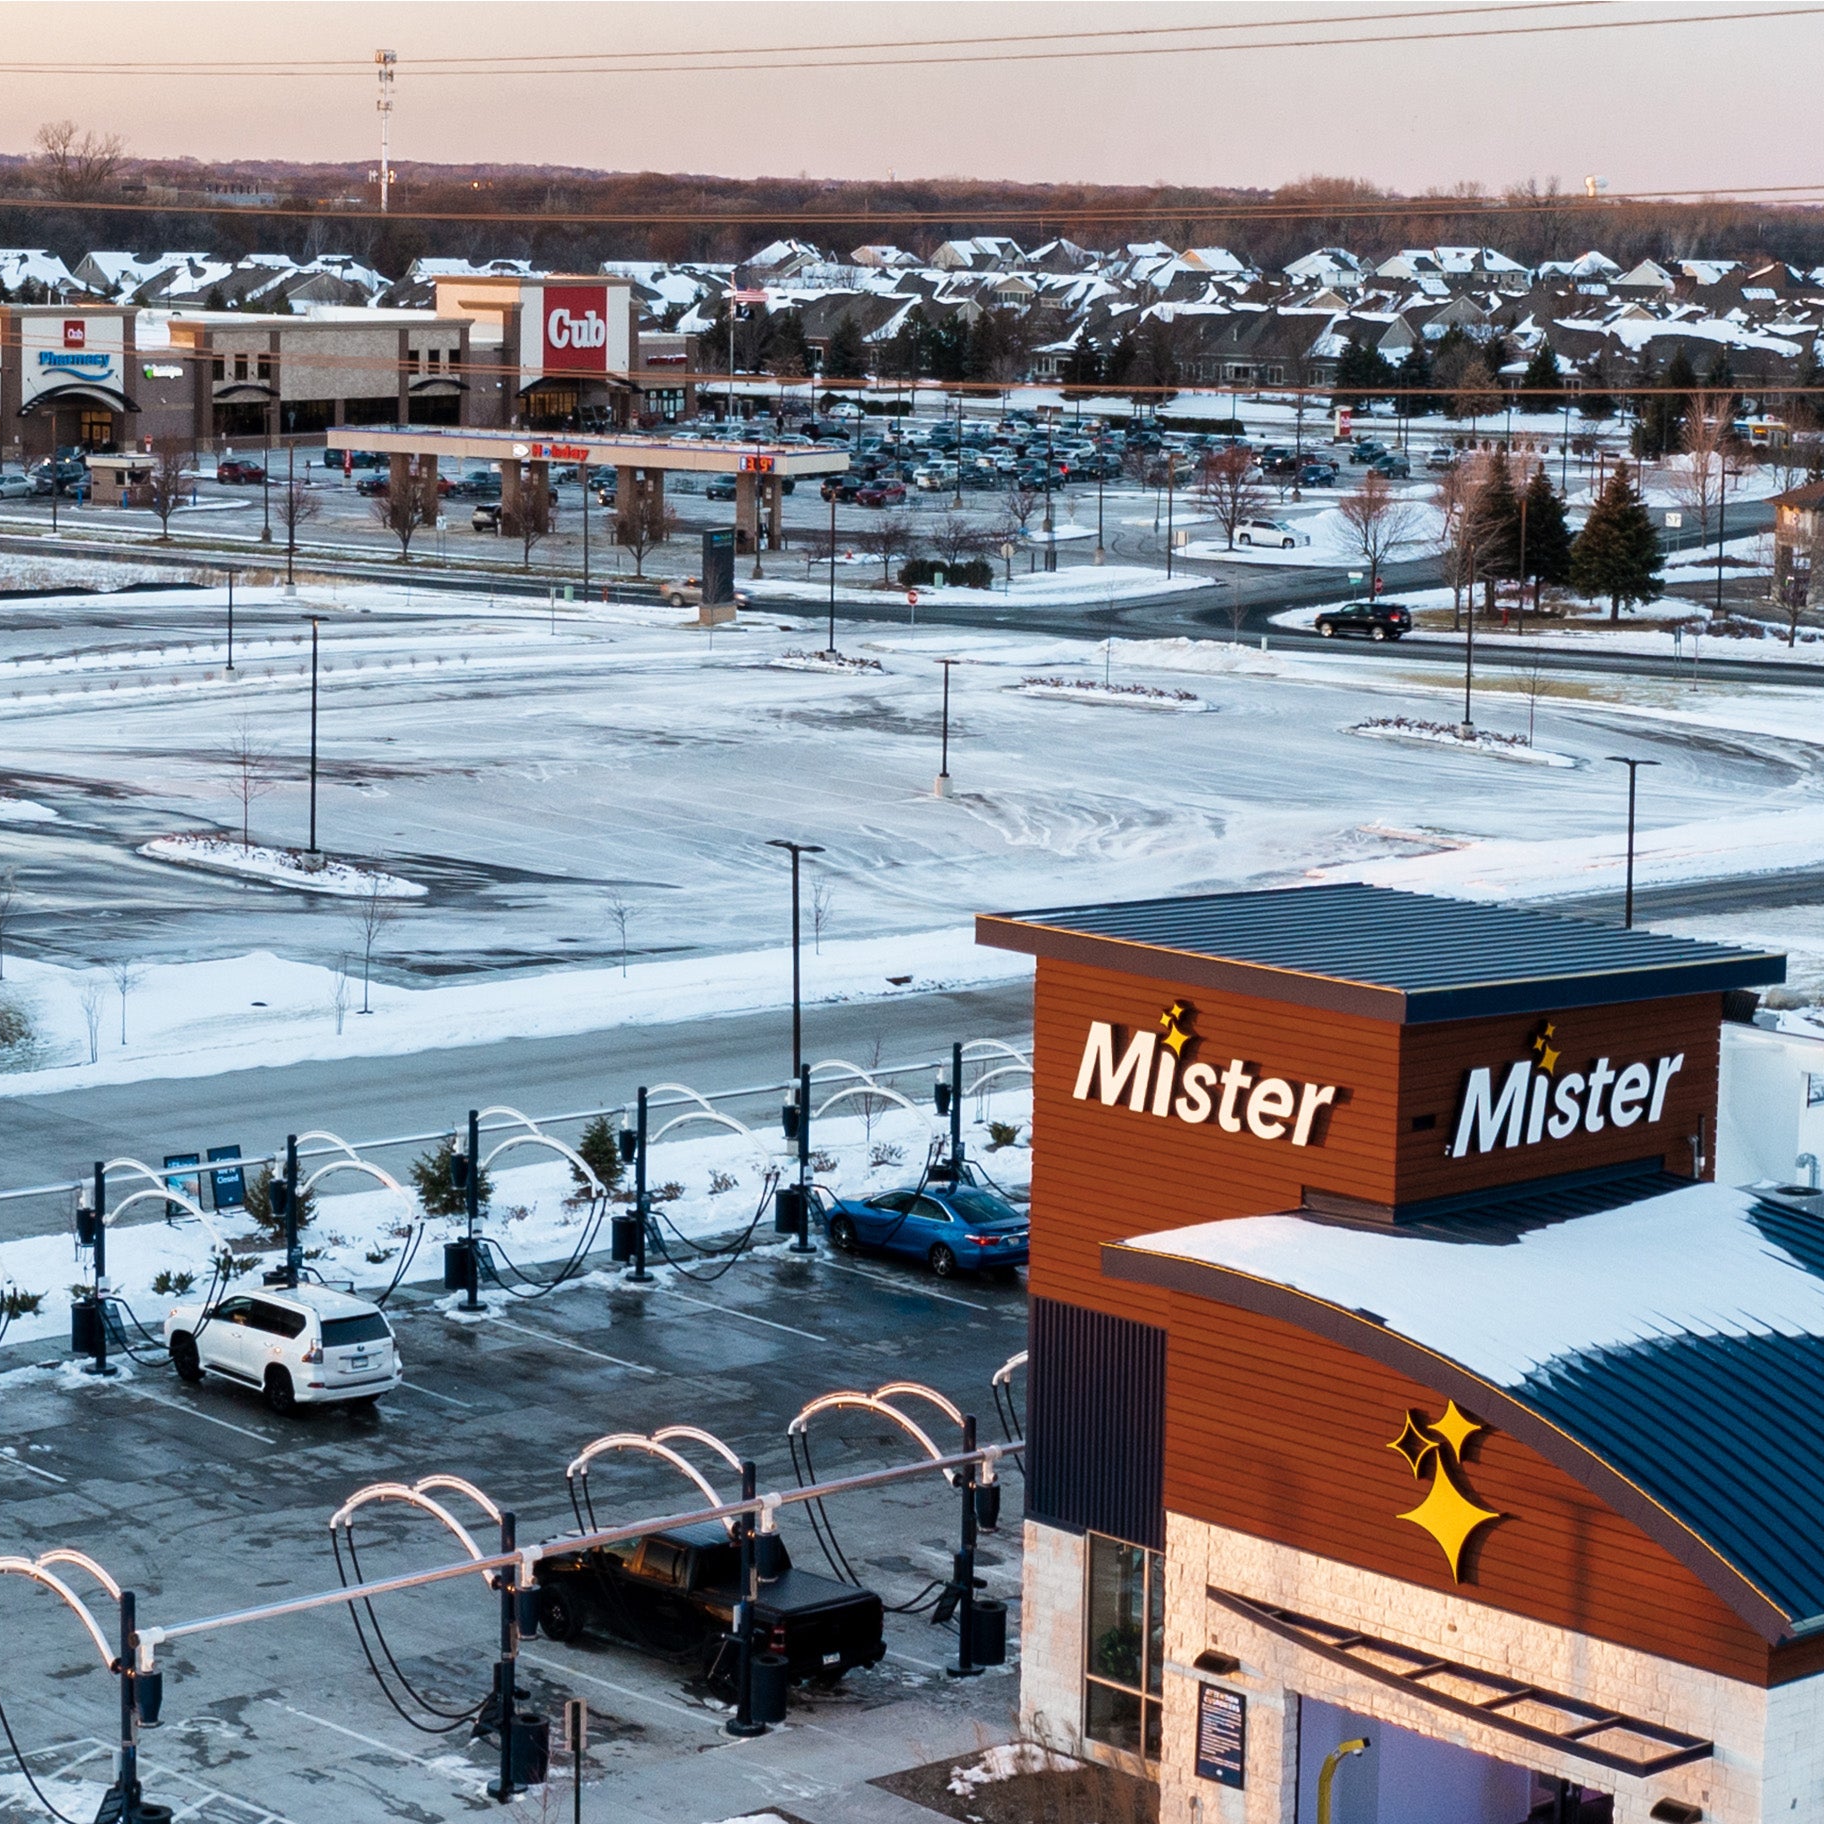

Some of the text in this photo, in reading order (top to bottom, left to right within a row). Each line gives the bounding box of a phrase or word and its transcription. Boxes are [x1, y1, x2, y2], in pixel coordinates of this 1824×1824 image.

[39, 351, 111, 368] Pharmacy
[548, 308, 606, 349] Cub
[1072, 1021, 1335, 1146] Mister
[1453, 1053, 1684, 1157] Mister
